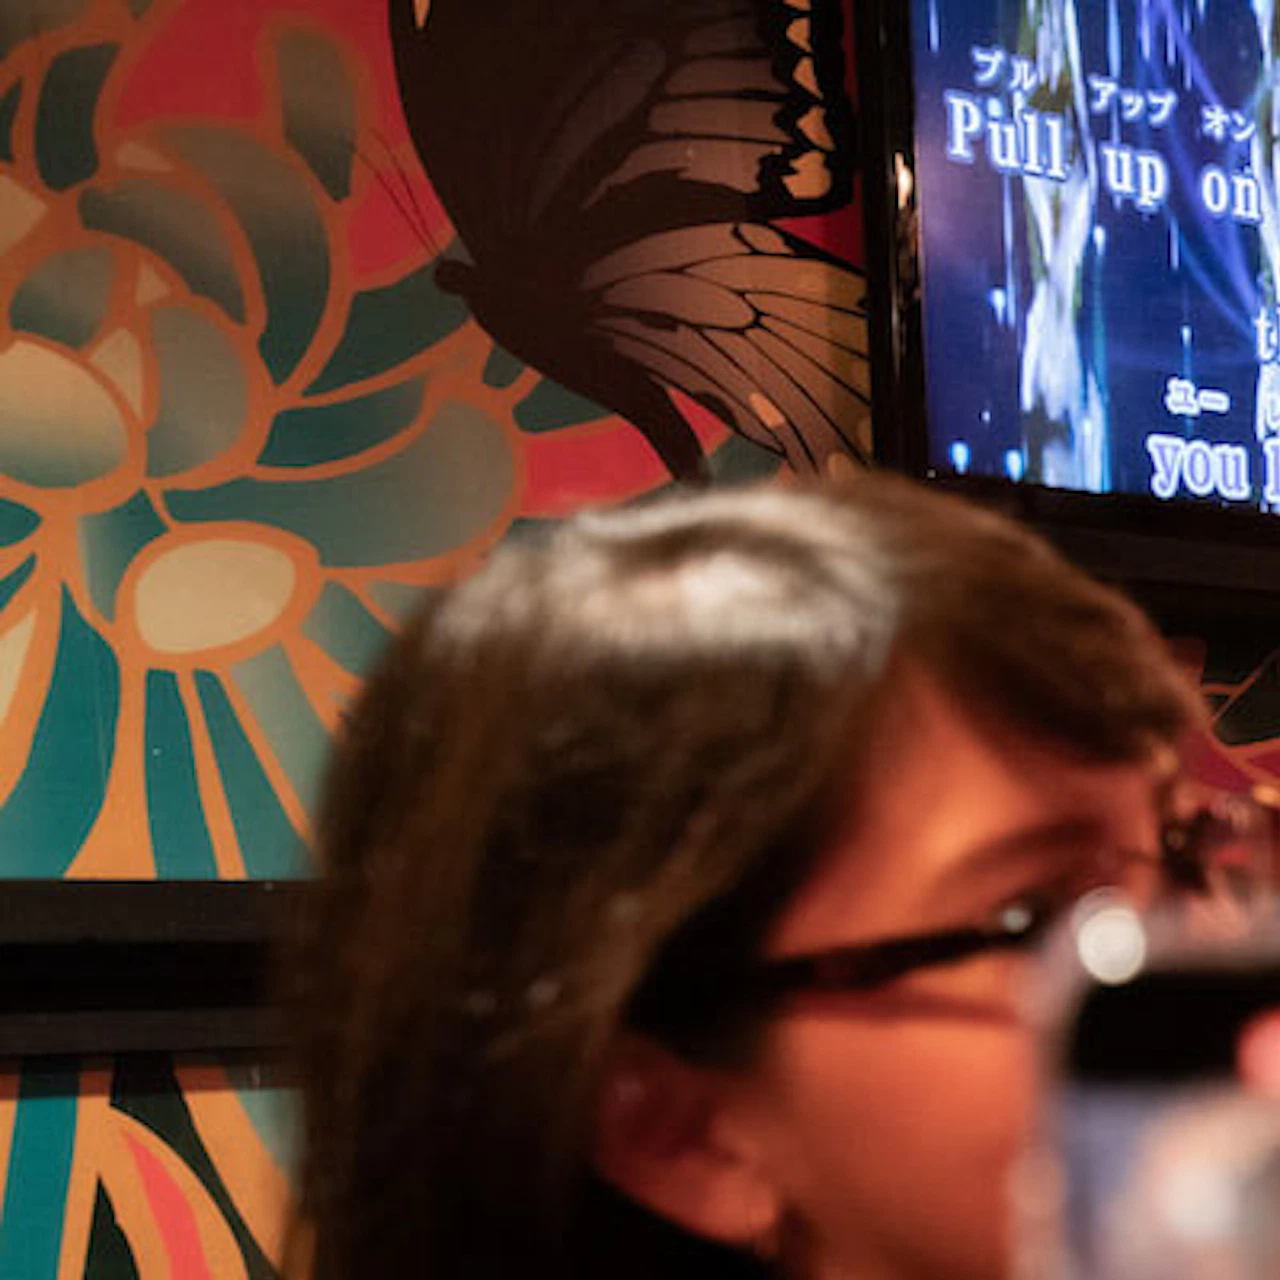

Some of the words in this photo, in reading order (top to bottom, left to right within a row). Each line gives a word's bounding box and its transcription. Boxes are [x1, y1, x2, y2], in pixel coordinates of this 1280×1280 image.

[1201, 103, 1256, 141] オン
[945, 92, 1067, 180] Pull
[1100, 144, 1169, 209] up
[1201, 164, 1260, 221] on
[1165, 378, 1231, 415] ユー
[1147, 434, 1251, 499] you
